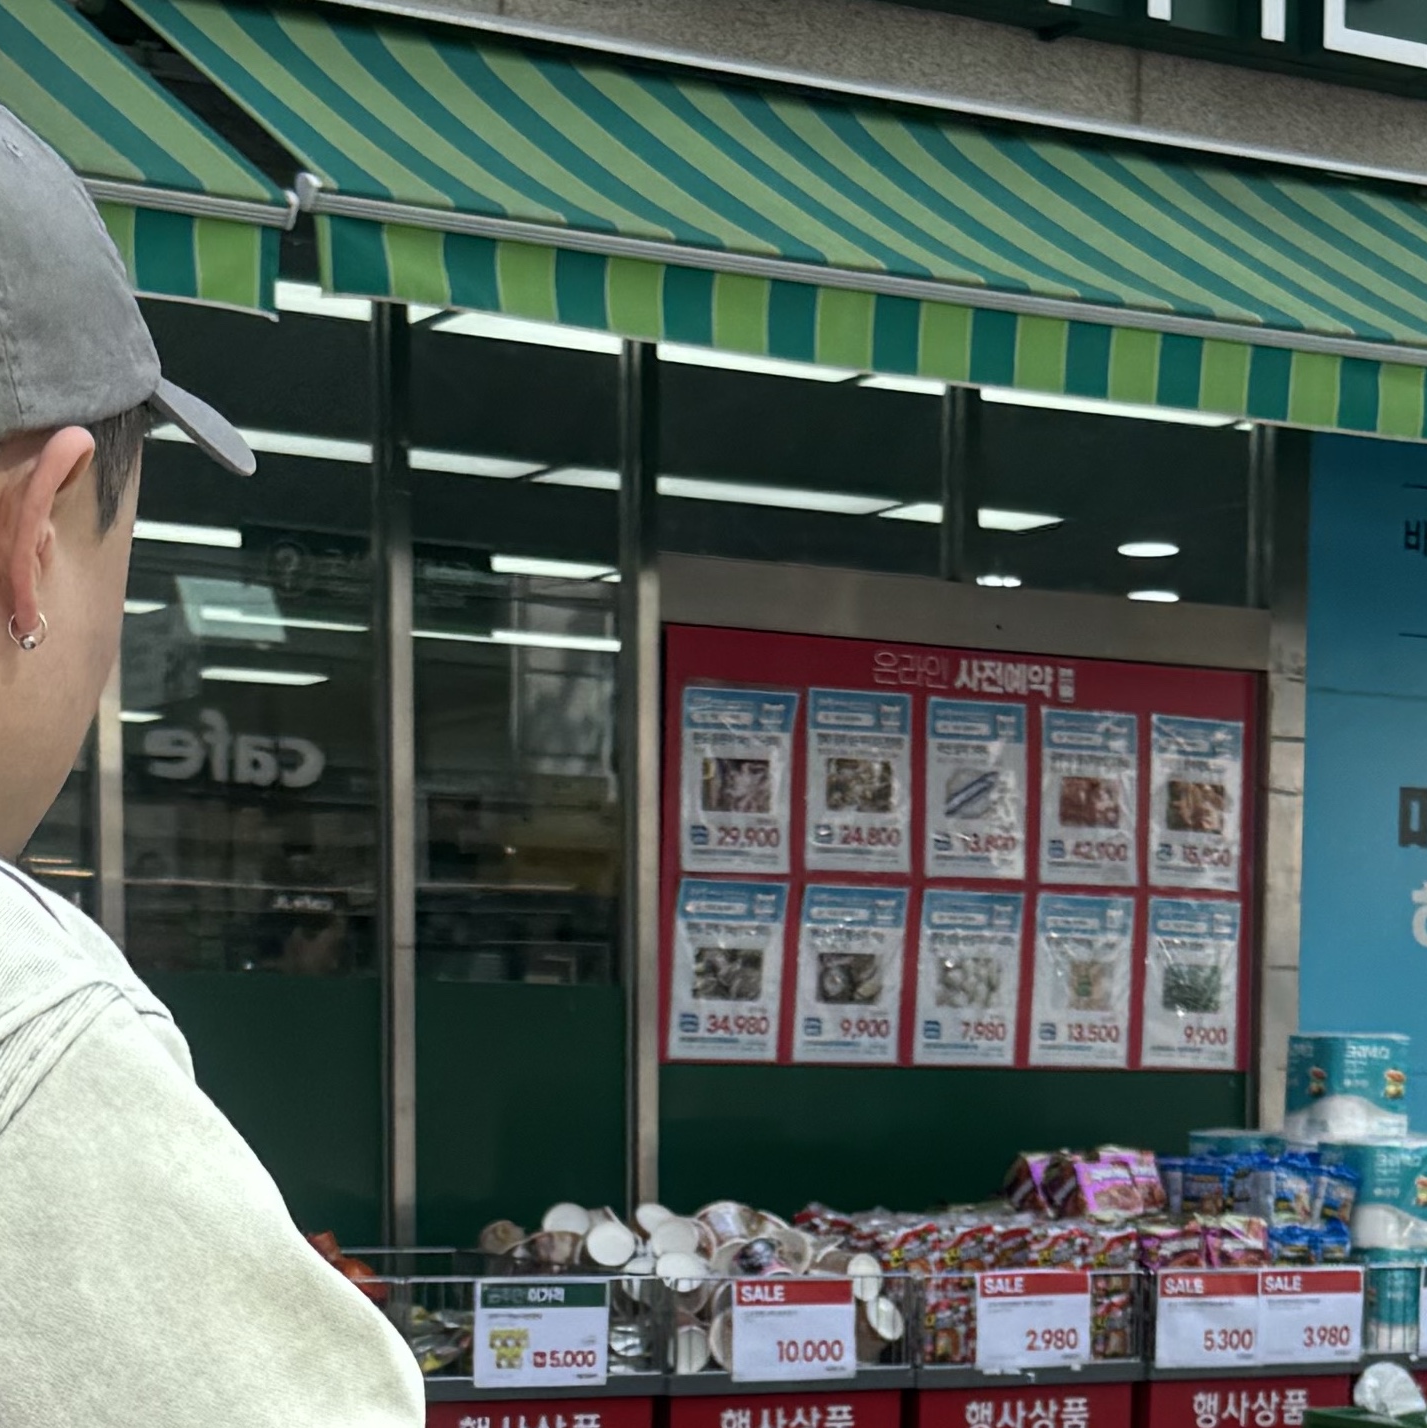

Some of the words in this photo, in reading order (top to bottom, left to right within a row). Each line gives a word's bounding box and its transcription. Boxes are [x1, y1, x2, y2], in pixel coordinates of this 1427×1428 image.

[873, 651, 950, 689] 온라인
[954, 658, 1054, 698] 사전예약
[982, 1276, 1025, 1295] SALE
[1164, 1277, 1205, 1295] SALE
[1263, 1275, 1303, 1293] SALE
[740, 1284, 786, 1304] SALE
